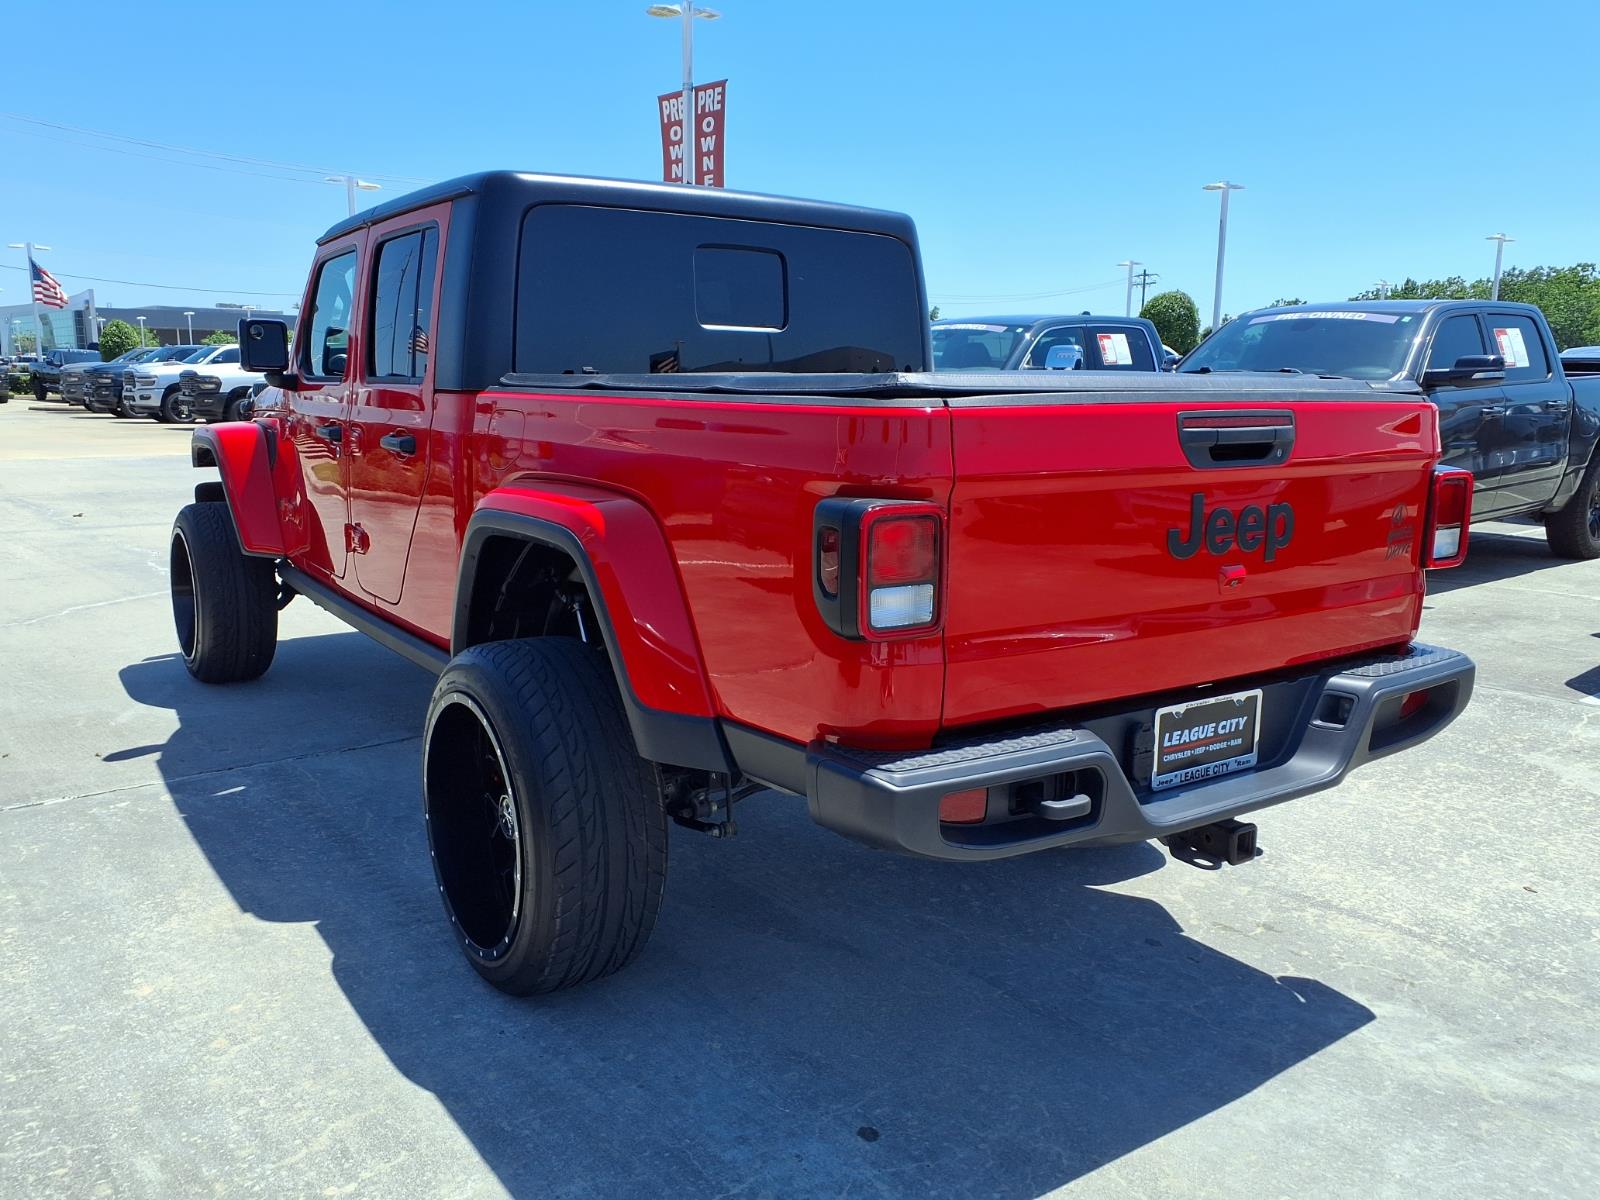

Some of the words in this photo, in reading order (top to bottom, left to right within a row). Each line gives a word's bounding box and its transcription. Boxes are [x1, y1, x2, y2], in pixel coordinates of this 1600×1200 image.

[698, 87, 722, 114] PRE
[669, 126, 684, 184] OWN
[1274, 311, 1367, 321] PRE-OWNED
[1167, 492, 1295, 562] Jeep
[1163, 722, 1216, 747] LEAGUE
[1217, 716, 1247, 735] CITY
[1163, 750, 1191, 762] CHRYSLER
[1180, 766, 1211, 783] LEAGUE
[1212, 761, 1231, 775] CITY
